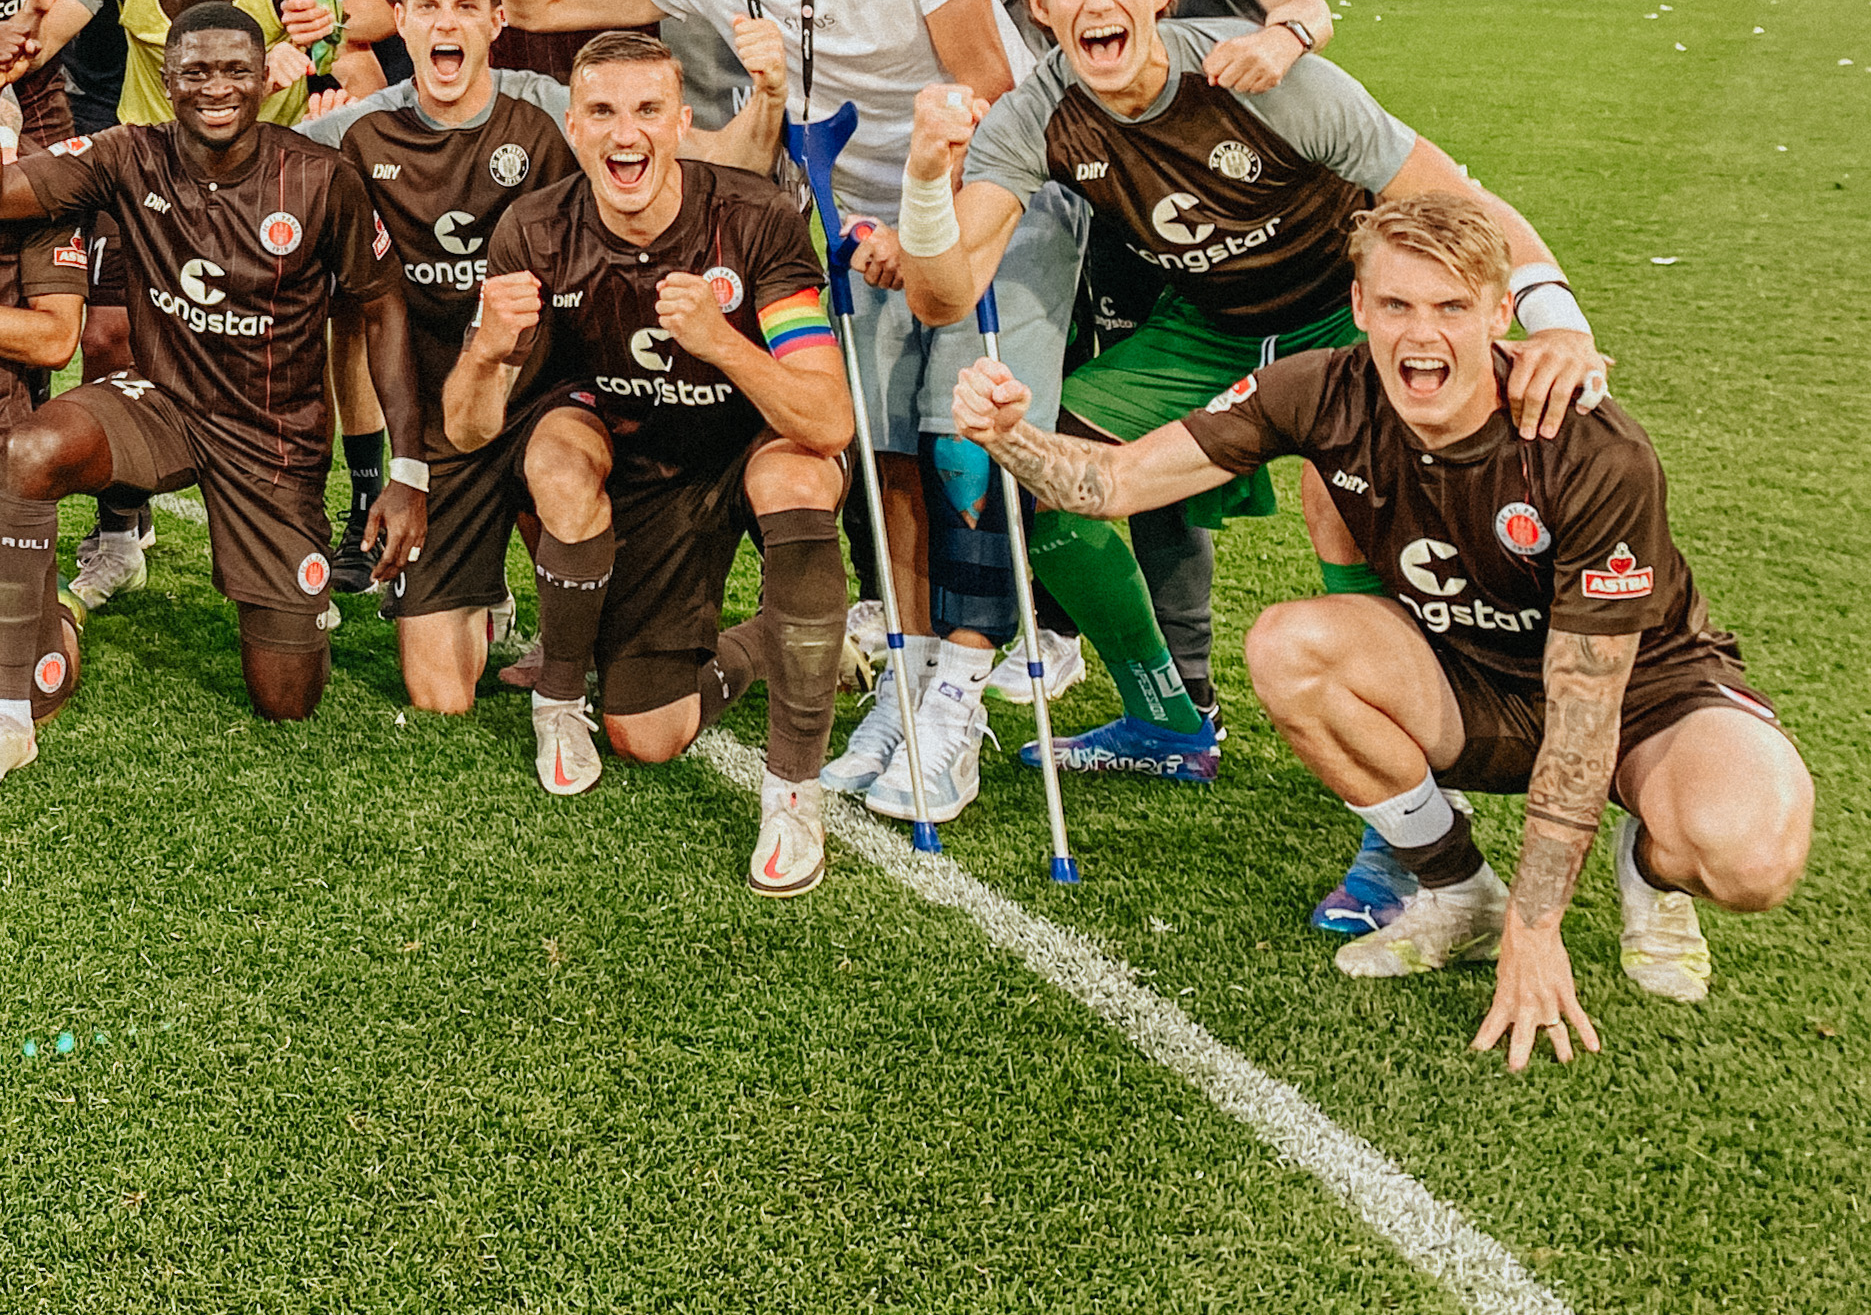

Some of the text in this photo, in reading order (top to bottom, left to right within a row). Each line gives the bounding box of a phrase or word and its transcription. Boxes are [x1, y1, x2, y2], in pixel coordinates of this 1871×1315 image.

[403, 259, 487, 291] congs
[149, 285, 275, 338] congstar
[1589, 576, 1650, 593] ASTRA
